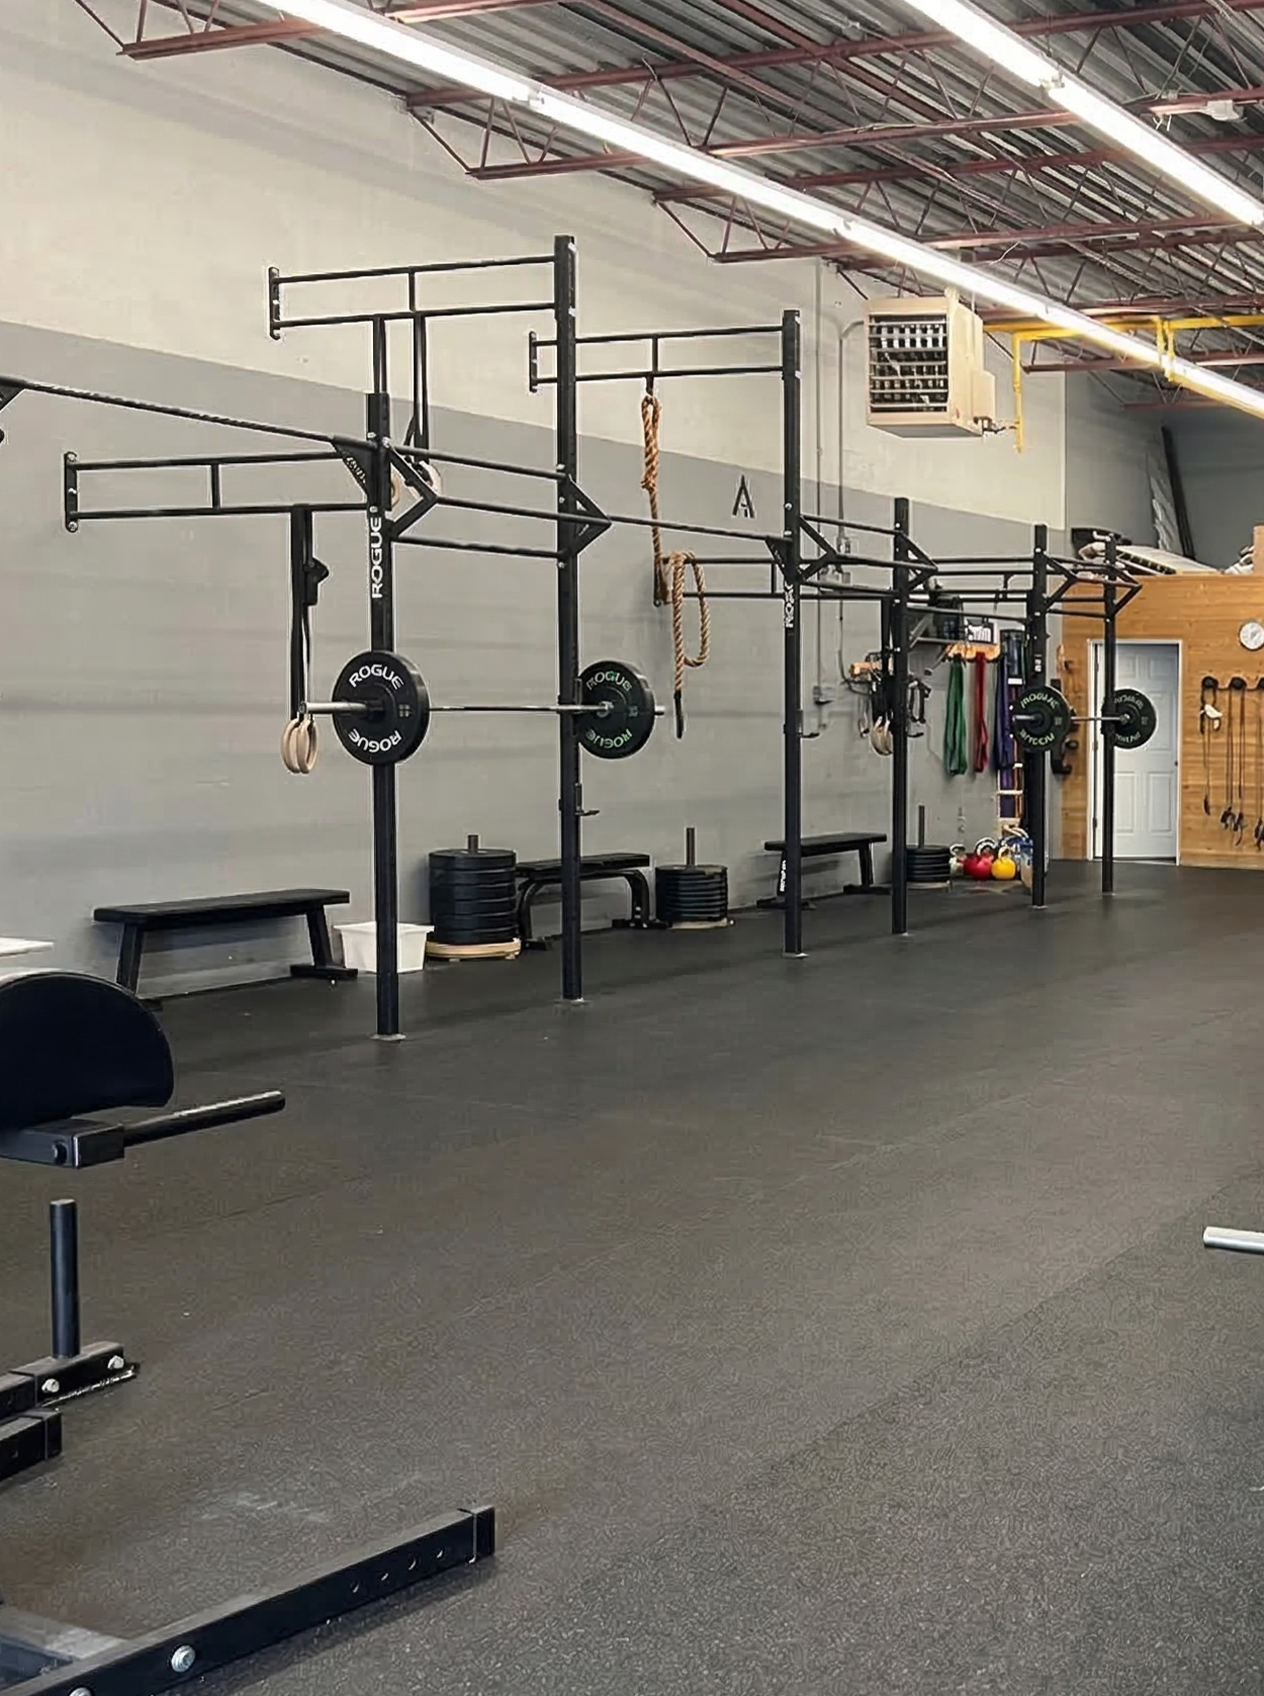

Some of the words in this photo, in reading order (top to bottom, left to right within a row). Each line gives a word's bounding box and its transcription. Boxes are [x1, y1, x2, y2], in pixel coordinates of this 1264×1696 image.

[370, 516, 384, 599] ROGUE
[348, 663, 405, 690] ROGUE
[347, 727, 403, 754] ROGUE
